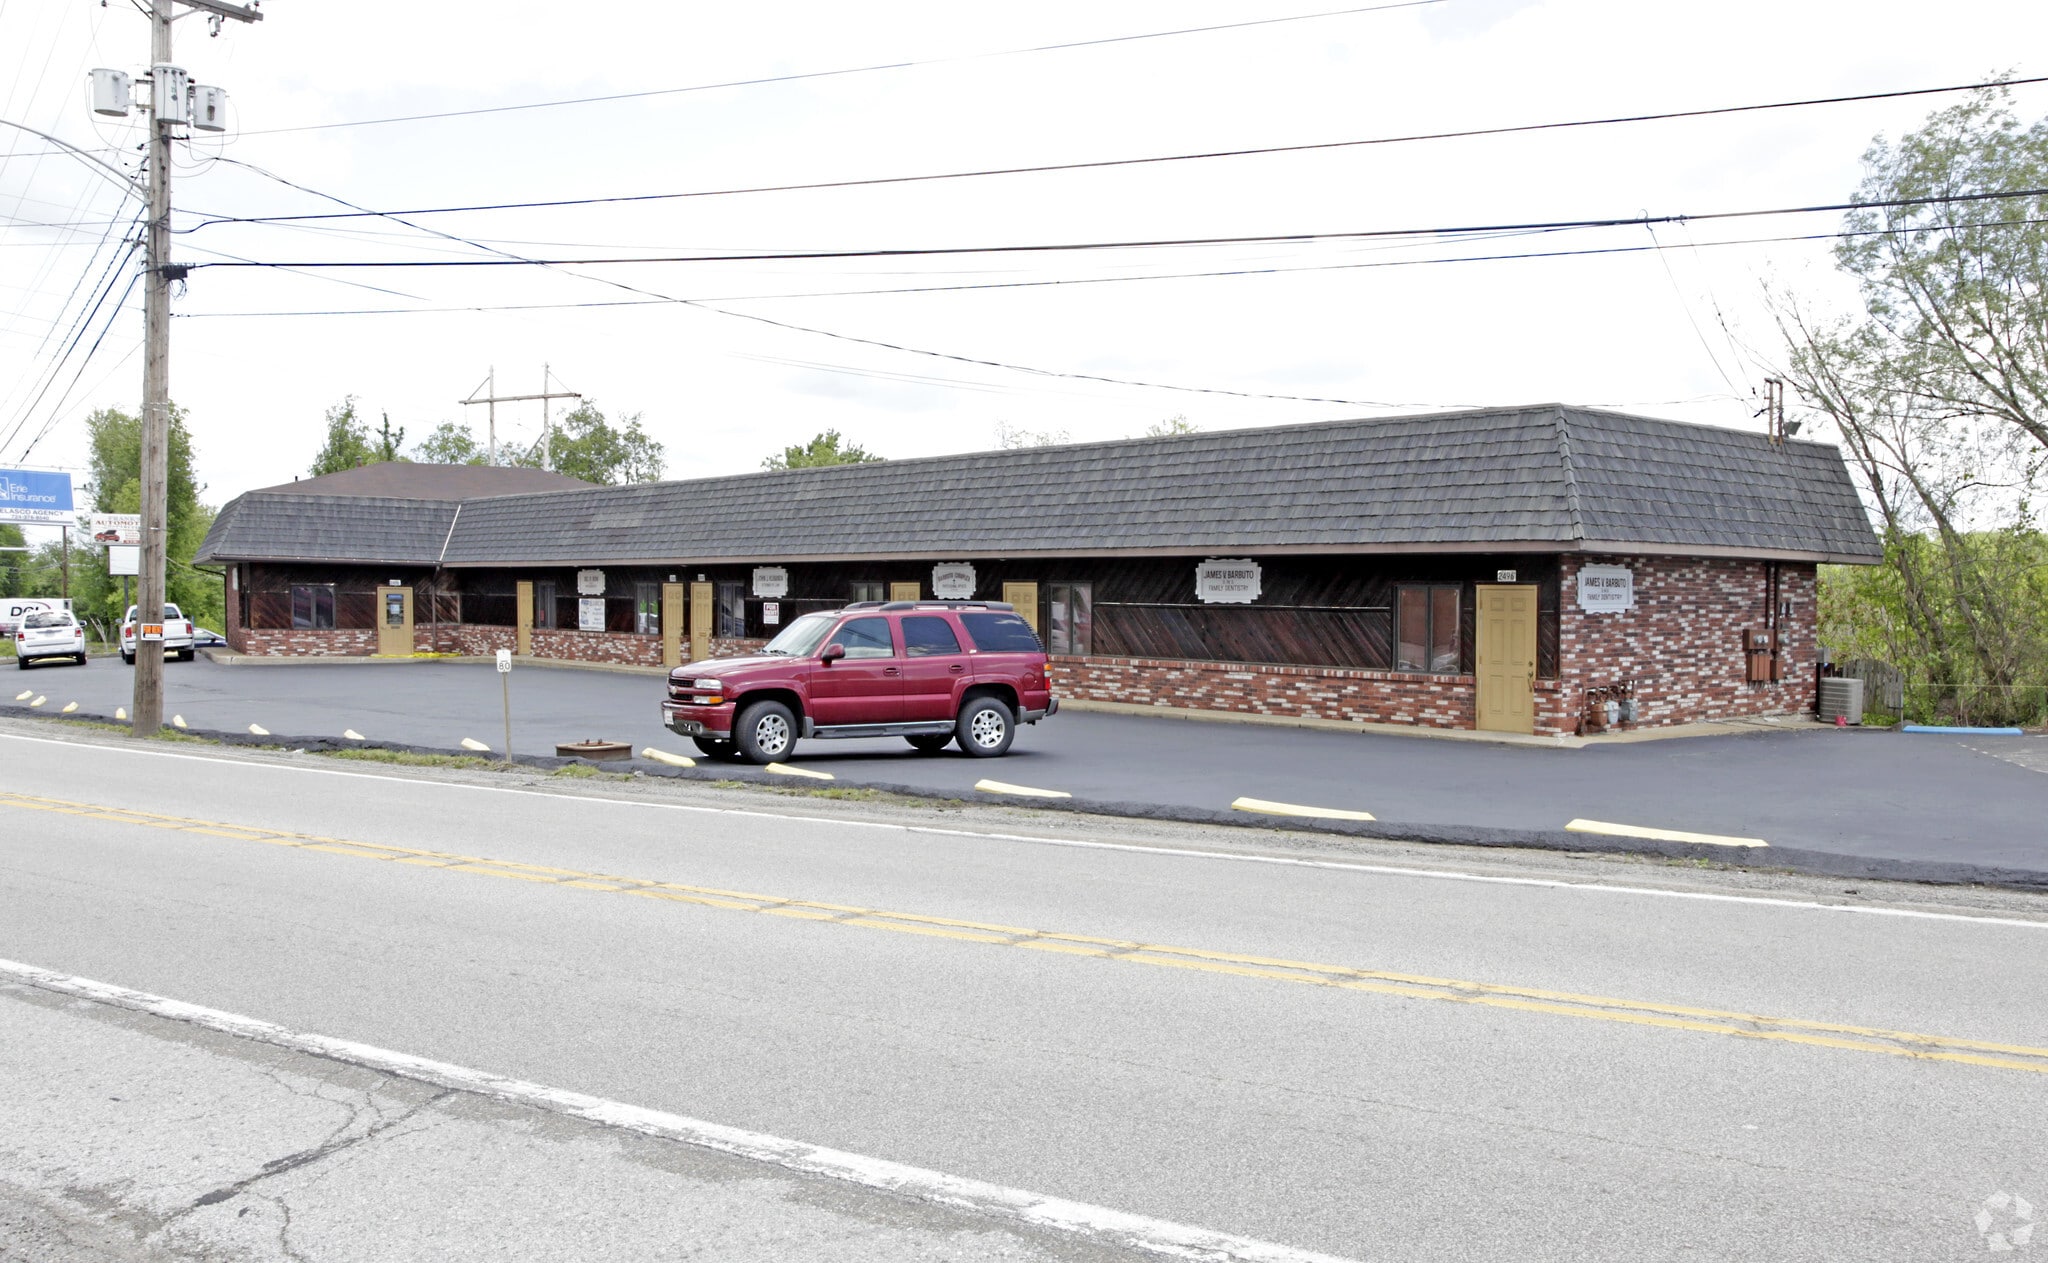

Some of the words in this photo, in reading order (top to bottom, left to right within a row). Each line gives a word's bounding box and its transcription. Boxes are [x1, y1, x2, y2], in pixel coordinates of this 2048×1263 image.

[10, 483, 28, 493] Erie
[10, 493, 56, 502] Insurance
[1203, 570, 1222, 580] JAMES
[1227, 570, 1255, 580] BARBUTO
[1584, 576, 1601, 587] JAMES
[1605, 577, 1627, 589] BARBUTO
[1208, 584, 1224, 592] FAMILY
